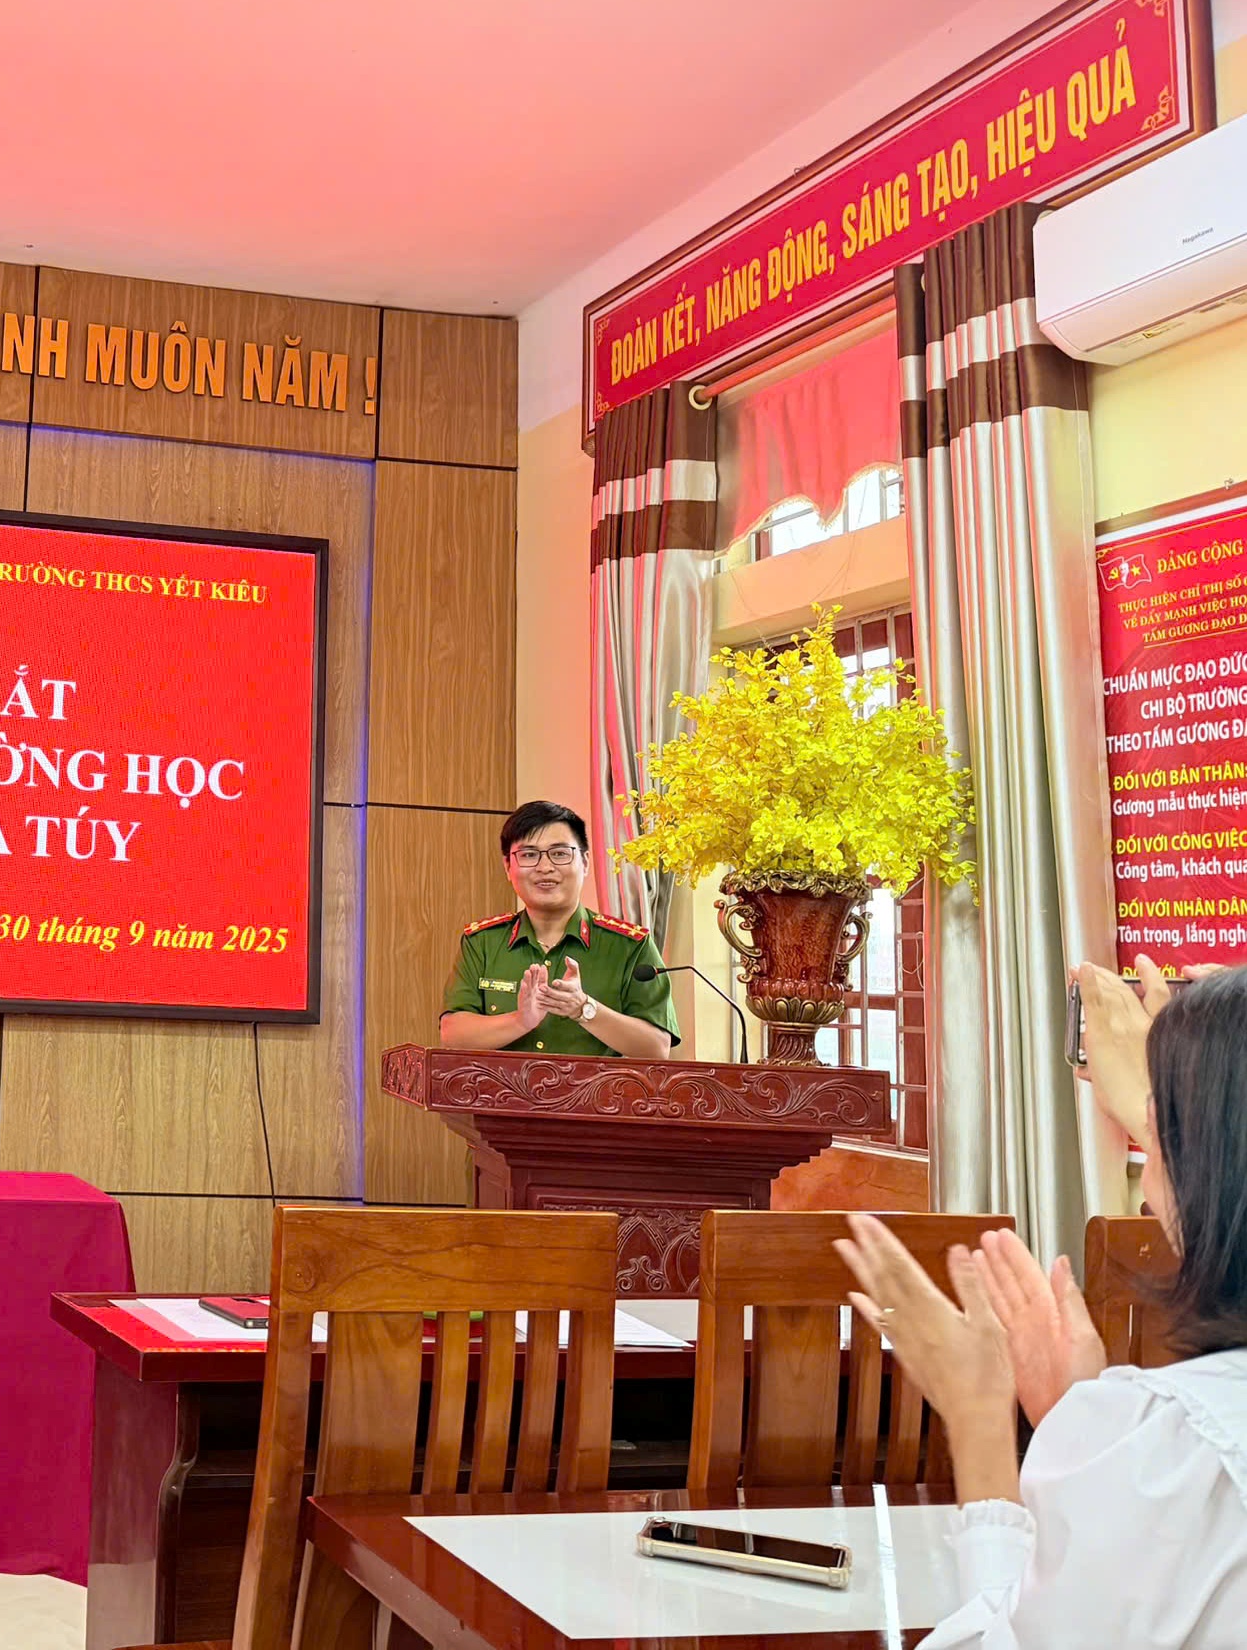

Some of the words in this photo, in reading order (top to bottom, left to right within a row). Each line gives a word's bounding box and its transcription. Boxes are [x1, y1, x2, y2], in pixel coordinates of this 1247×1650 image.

[611, 325, 657, 386] ĐOÀN
[662, 279, 701, 358] KẾT,
[706, 257, 761, 335] NĂNG
[767, 230, 835, 303] ĐỘNG,
[841, 166, 910, 259] SÁNG
[917, 139, 978, 222] TẠO,
[986, 88, 1056, 178] HIỆU
[1065, 18, 1136, 140] QUẢ
[85, 321, 226, 398] MUÔN
[242, 335, 348, 412] NĂM
[363, 357, 377, 415] !
[1157, 549, 1197, 574] ĐẢNG
[1201, 539, 1243, 565] CỘNG
[91, 571, 153, 594] THCS
[158, 575, 204, 599] YẾT
[210, 579, 267, 604] KIÊU
[1118, 598, 1148, 613] THỰC
[1150, 590, 1178, 606] HIỆN
[1203, 581, 1223, 595] THỊ
[1225, 573, 1242, 590] SỐ
[1164, 604, 1197, 621] MẠNH
[1199, 598, 1228, 614] VIỆC
[1230, 594, 1247, 608] HỌ
[1168, 620, 1209, 638] GƯƠNG
[1211, 614, 1236, 630] ĐẠO
[1103, 665, 1148, 695] CHUẨN
[1151, 662, 1183, 692] MỰC
[1184, 659, 1217, 686] ĐẠO
[1140, 700, 1164, 720] CHI
[1166, 691, 1186, 720] BỘ
[1187, 685, 1247, 713] TRƯỜNG
[1106, 735, 1142, 754] THEO
[1143, 723, 1174, 749] TẤM
[1176, 720, 1230, 745] GƯƠNG
[123, 752, 245, 809] HỌC
[1113, 769, 1140, 792] ĐỐI
[1141, 766, 1167, 788] VỚI
[1169, 763, 1200, 786] BẢN
[1113, 799, 1155, 817] Gương
[1157, 790, 1185, 812] mẫu
[1187, 790, 1217, 814] thực
[1219, 786, 1247, 811] hiện
[26, 804, 142, 863] TÚY
[1116, 833, 1141, 855] ĐỐI
[1143, 830, 1168, 852] VỚI
[1171, 831, 1212, 851] CÔNG
[1116, 861, 1148, 882] Công
[1150, 860, 1179, 879] tâm,
[1181, 856, 1222, 876] khách
[1224, 858, 1247, 879] qua
[1119, 898, 1143, 918] ĐỐI
[1145, 897, 1170, 917] VỚI
[1173, 896, 1216, 917] NHÂN
[37, 914, 119, 952] tháng
[129, 920, 145, 948] 9
[152, 925, 214, 950] năm
[222, 925, 288, 954] 2025
[1118, 925, 1141, 944] Tôn
[1143, 926, 1184, 949] trọng,
[1185, 921, 1216, 947] lắng
[1219, 923, 1247, 947] ngh
